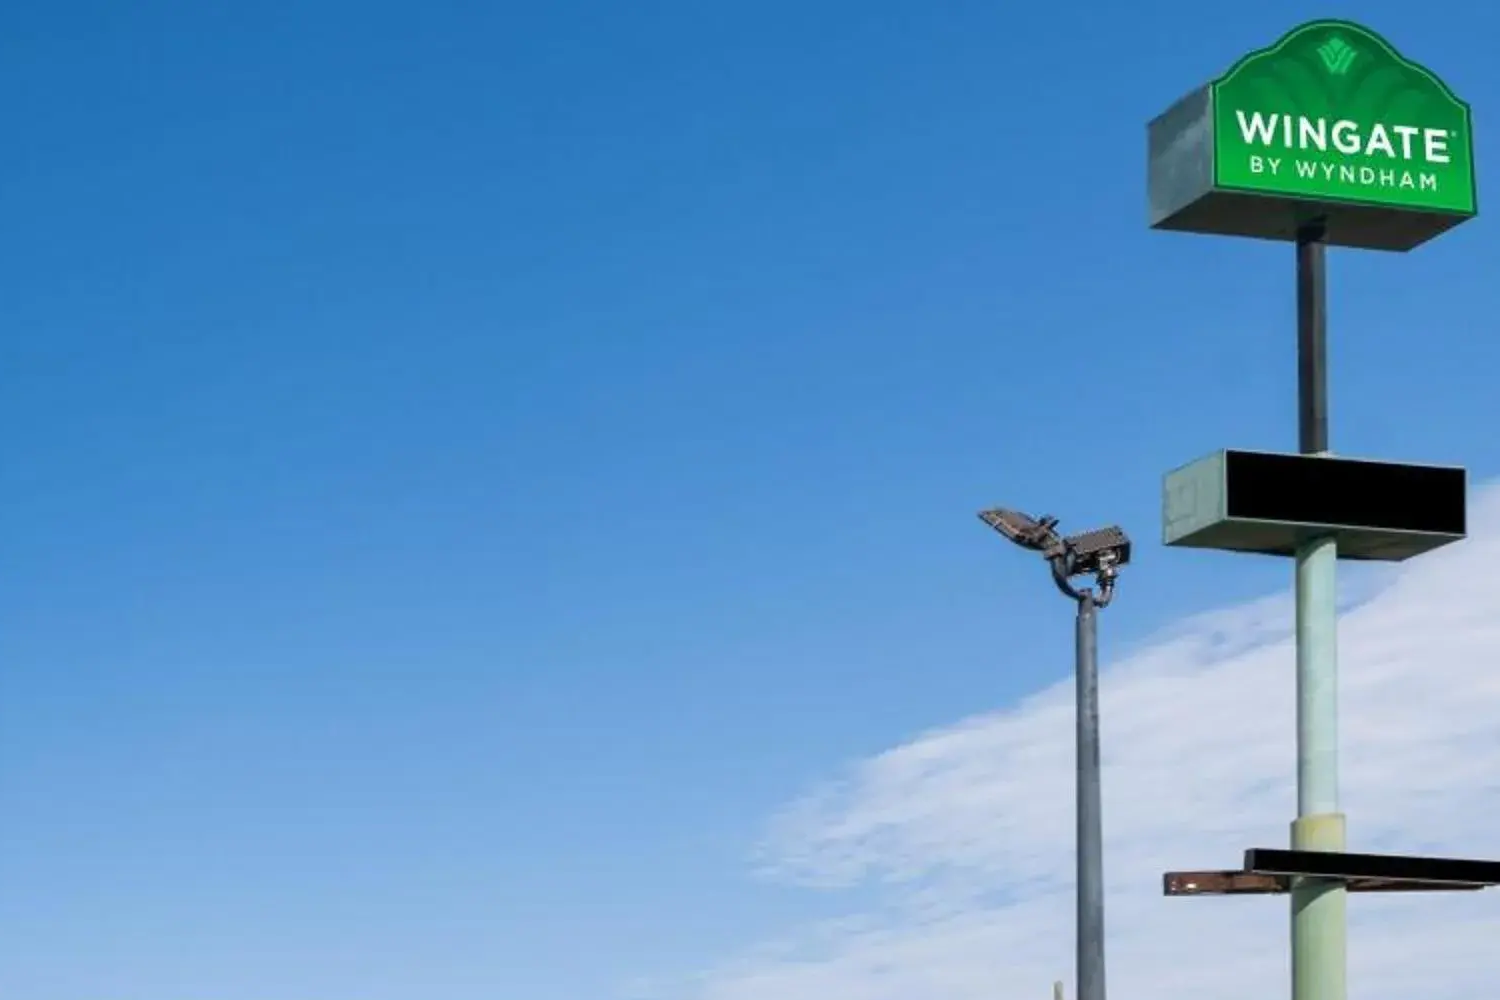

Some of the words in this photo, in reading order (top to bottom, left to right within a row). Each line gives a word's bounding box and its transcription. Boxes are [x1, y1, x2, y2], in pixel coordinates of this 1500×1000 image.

[1236, 110, 1451, 163] WINGATE
[1250, 156, 1282, 175] BY
[1295, 159, 1438, 192] WYNDHAM
